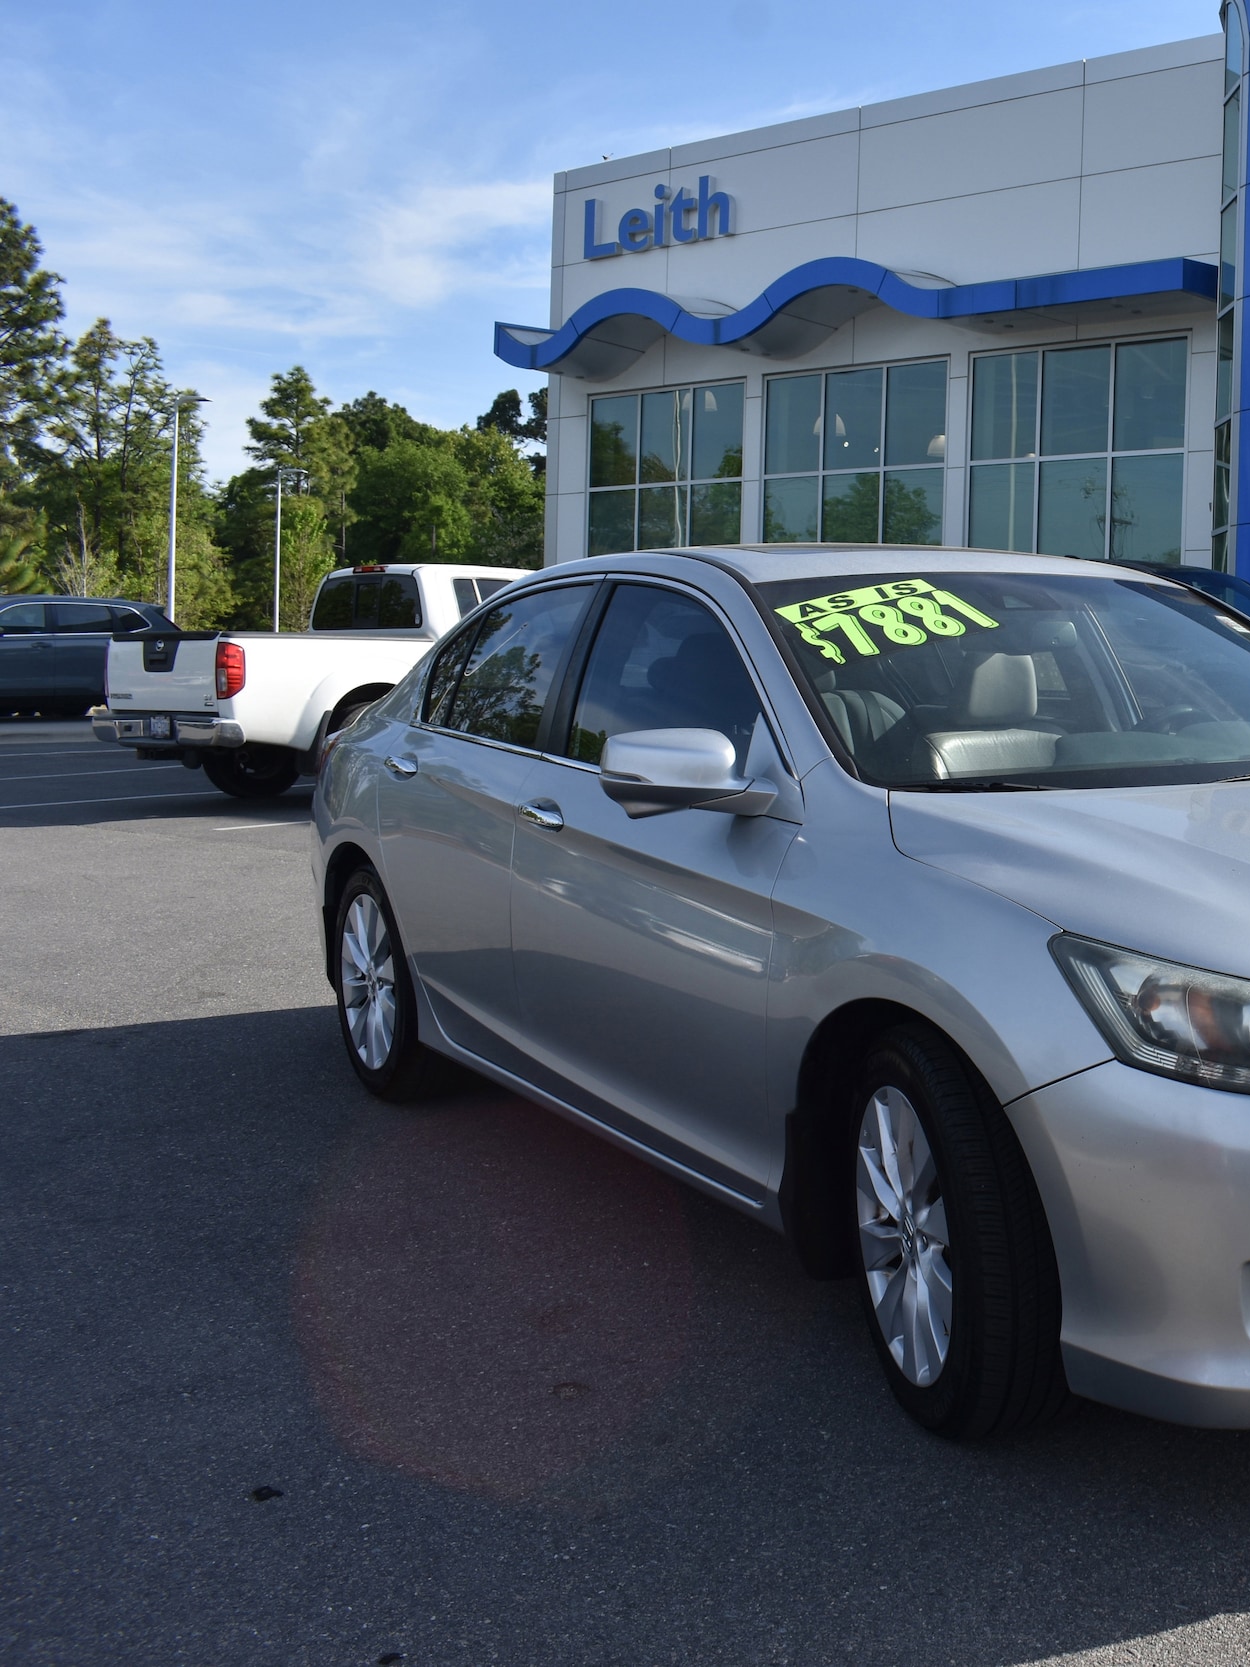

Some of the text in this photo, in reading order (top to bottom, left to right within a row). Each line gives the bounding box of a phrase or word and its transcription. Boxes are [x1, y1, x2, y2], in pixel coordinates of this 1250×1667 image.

[584, 175, 731, 260] Leith
[795, 590, 999, 664] $7881
[800, 583, 918, 618] AS IS
